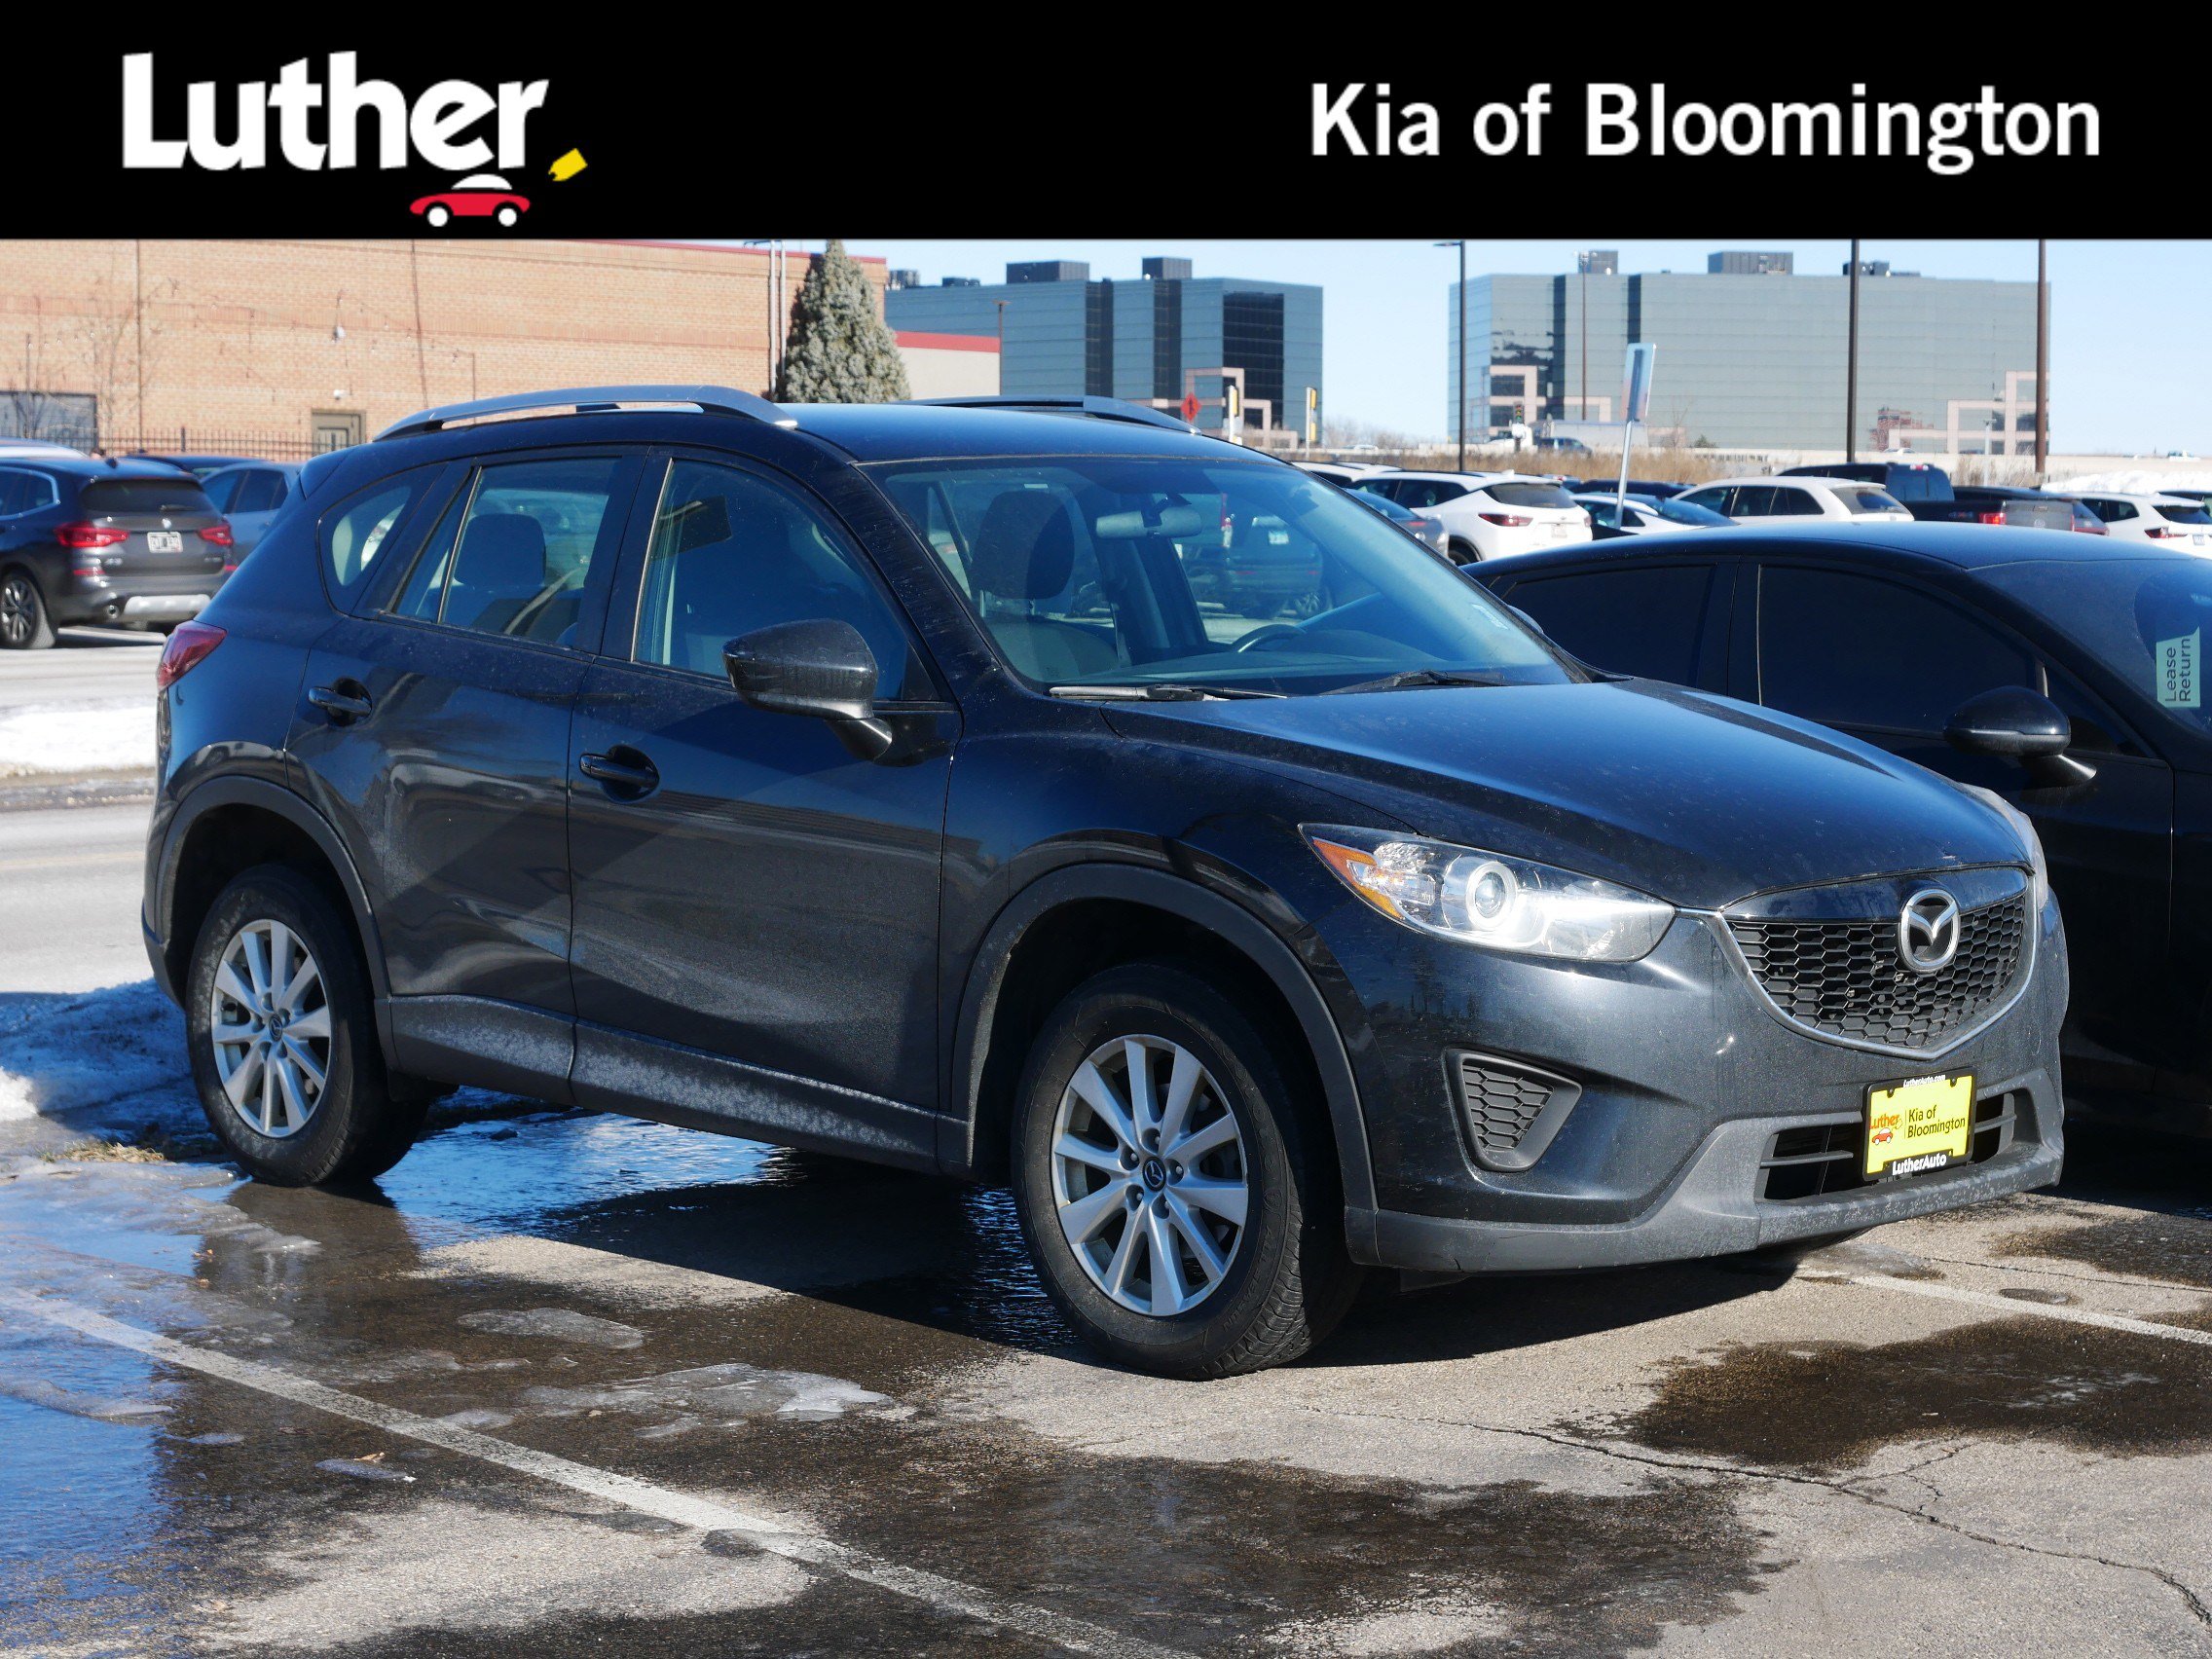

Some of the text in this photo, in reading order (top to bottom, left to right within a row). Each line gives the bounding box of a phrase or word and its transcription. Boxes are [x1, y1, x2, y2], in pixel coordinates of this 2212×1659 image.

[2165, 646, 2176, 702] Lease
[2179, 638, 2191, 702] Return
[1869, 1113, 1900, 1129] Luther
[1908, 1104, 1937, 1124] Kia of
[1907, 1117, 1966, 1138] Bloomington
[1892, 1153, 1947, 1175] LutherAuto
